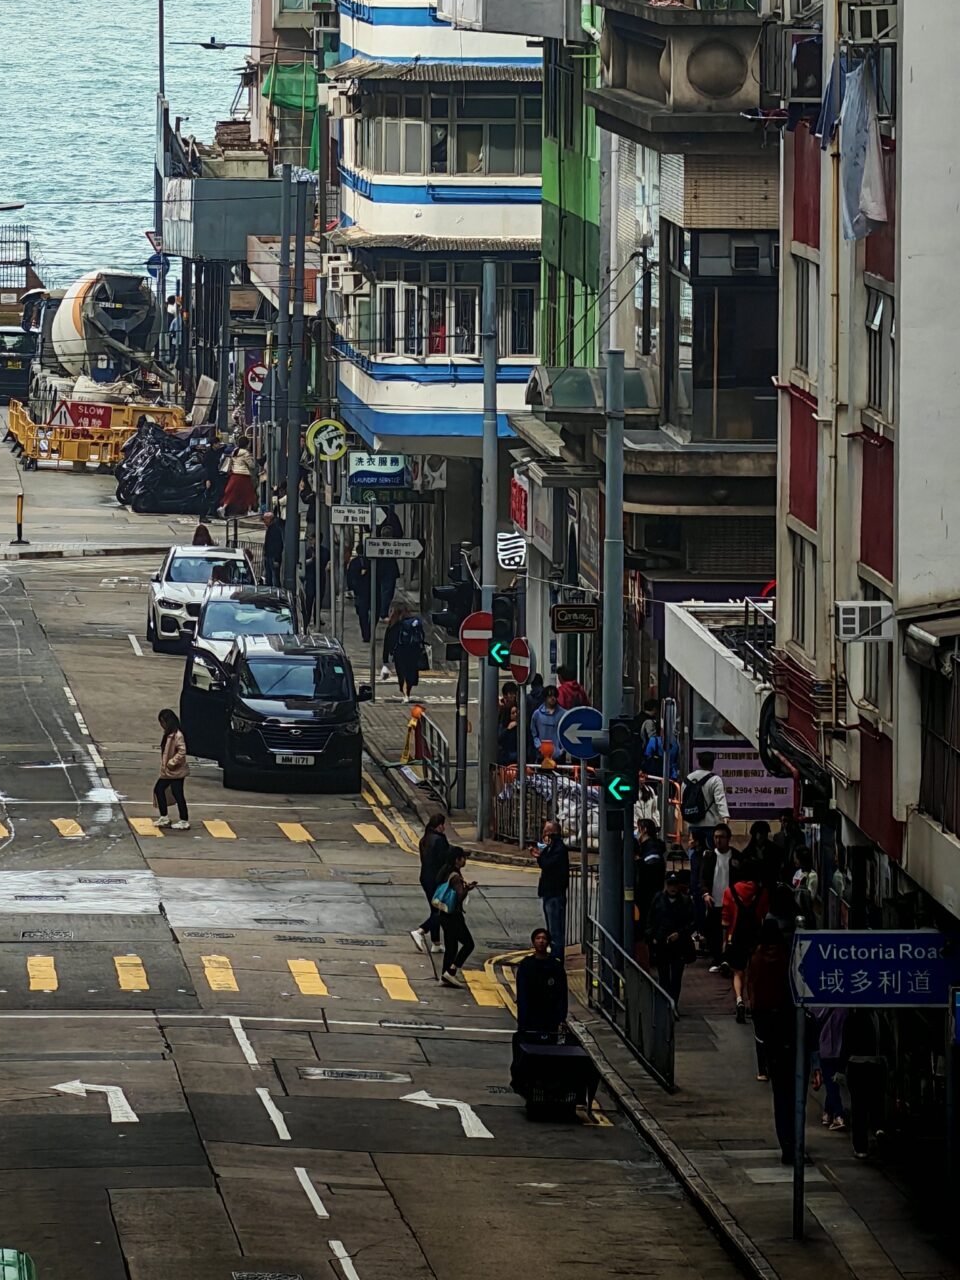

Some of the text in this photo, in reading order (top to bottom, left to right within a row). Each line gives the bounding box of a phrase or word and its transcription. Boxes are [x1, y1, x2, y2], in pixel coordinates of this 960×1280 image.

[77, 405, 105, 416] SLOW
[354, 455, 400, 467] 洗衣服務
[818, 943, 895, 960] Victoria
[819, 969, 932, 995] 域多利道
